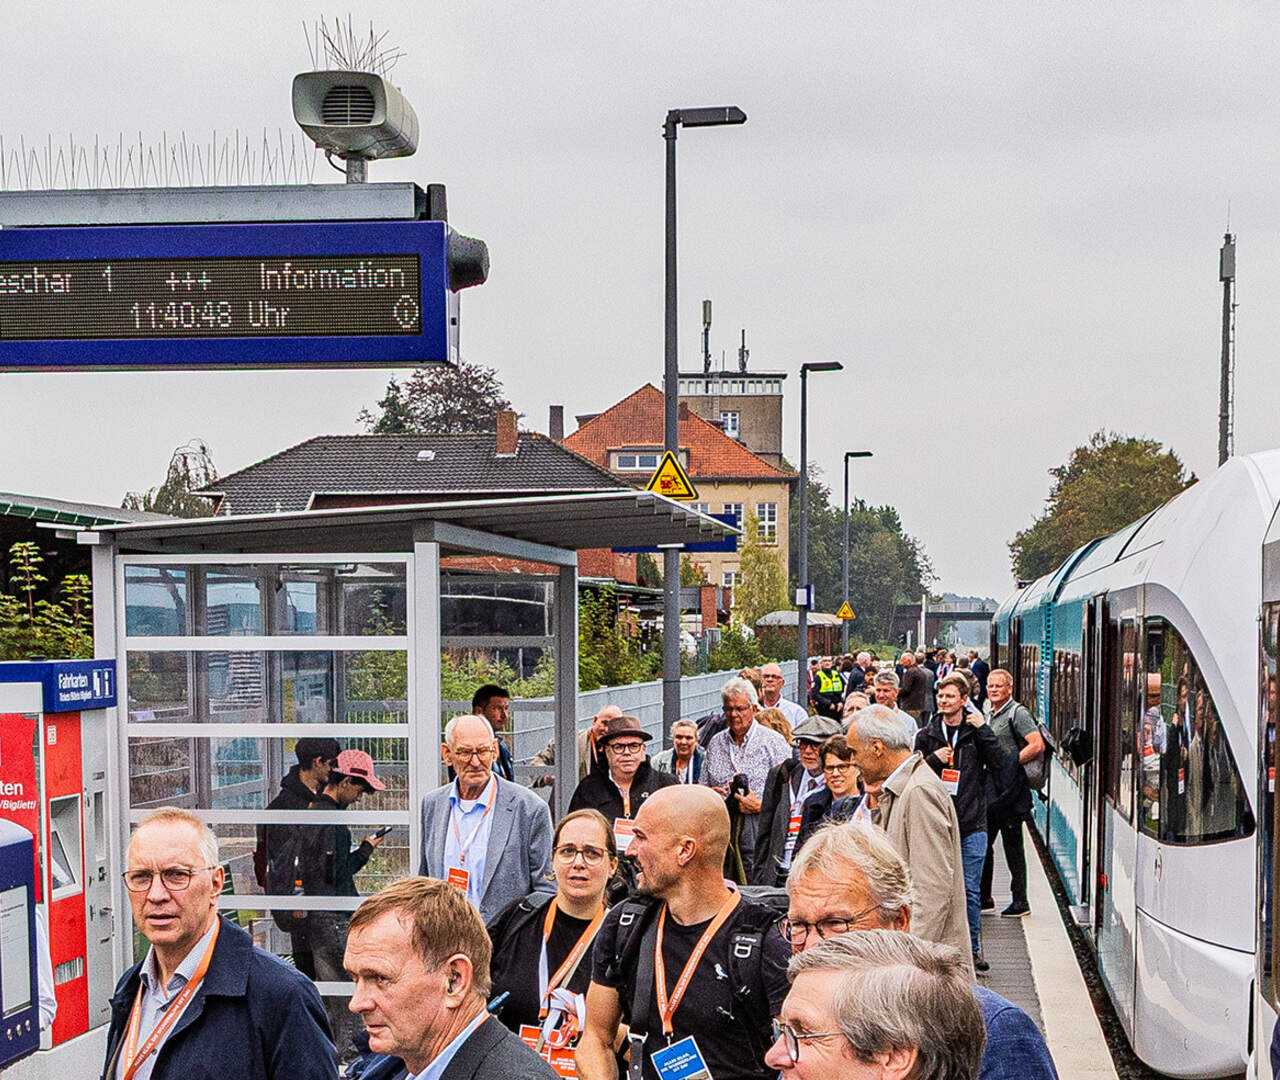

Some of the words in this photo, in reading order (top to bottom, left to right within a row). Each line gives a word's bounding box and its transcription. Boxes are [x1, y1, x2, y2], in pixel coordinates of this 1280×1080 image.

[102, 265, 113, 293] 1
[260, 261, 407, 290] Information
[130, 301, 232, 328] 11:40:48
[248, 300, 290, 327] Uhr
[58, 673, 89, 689] Fahrkarten
